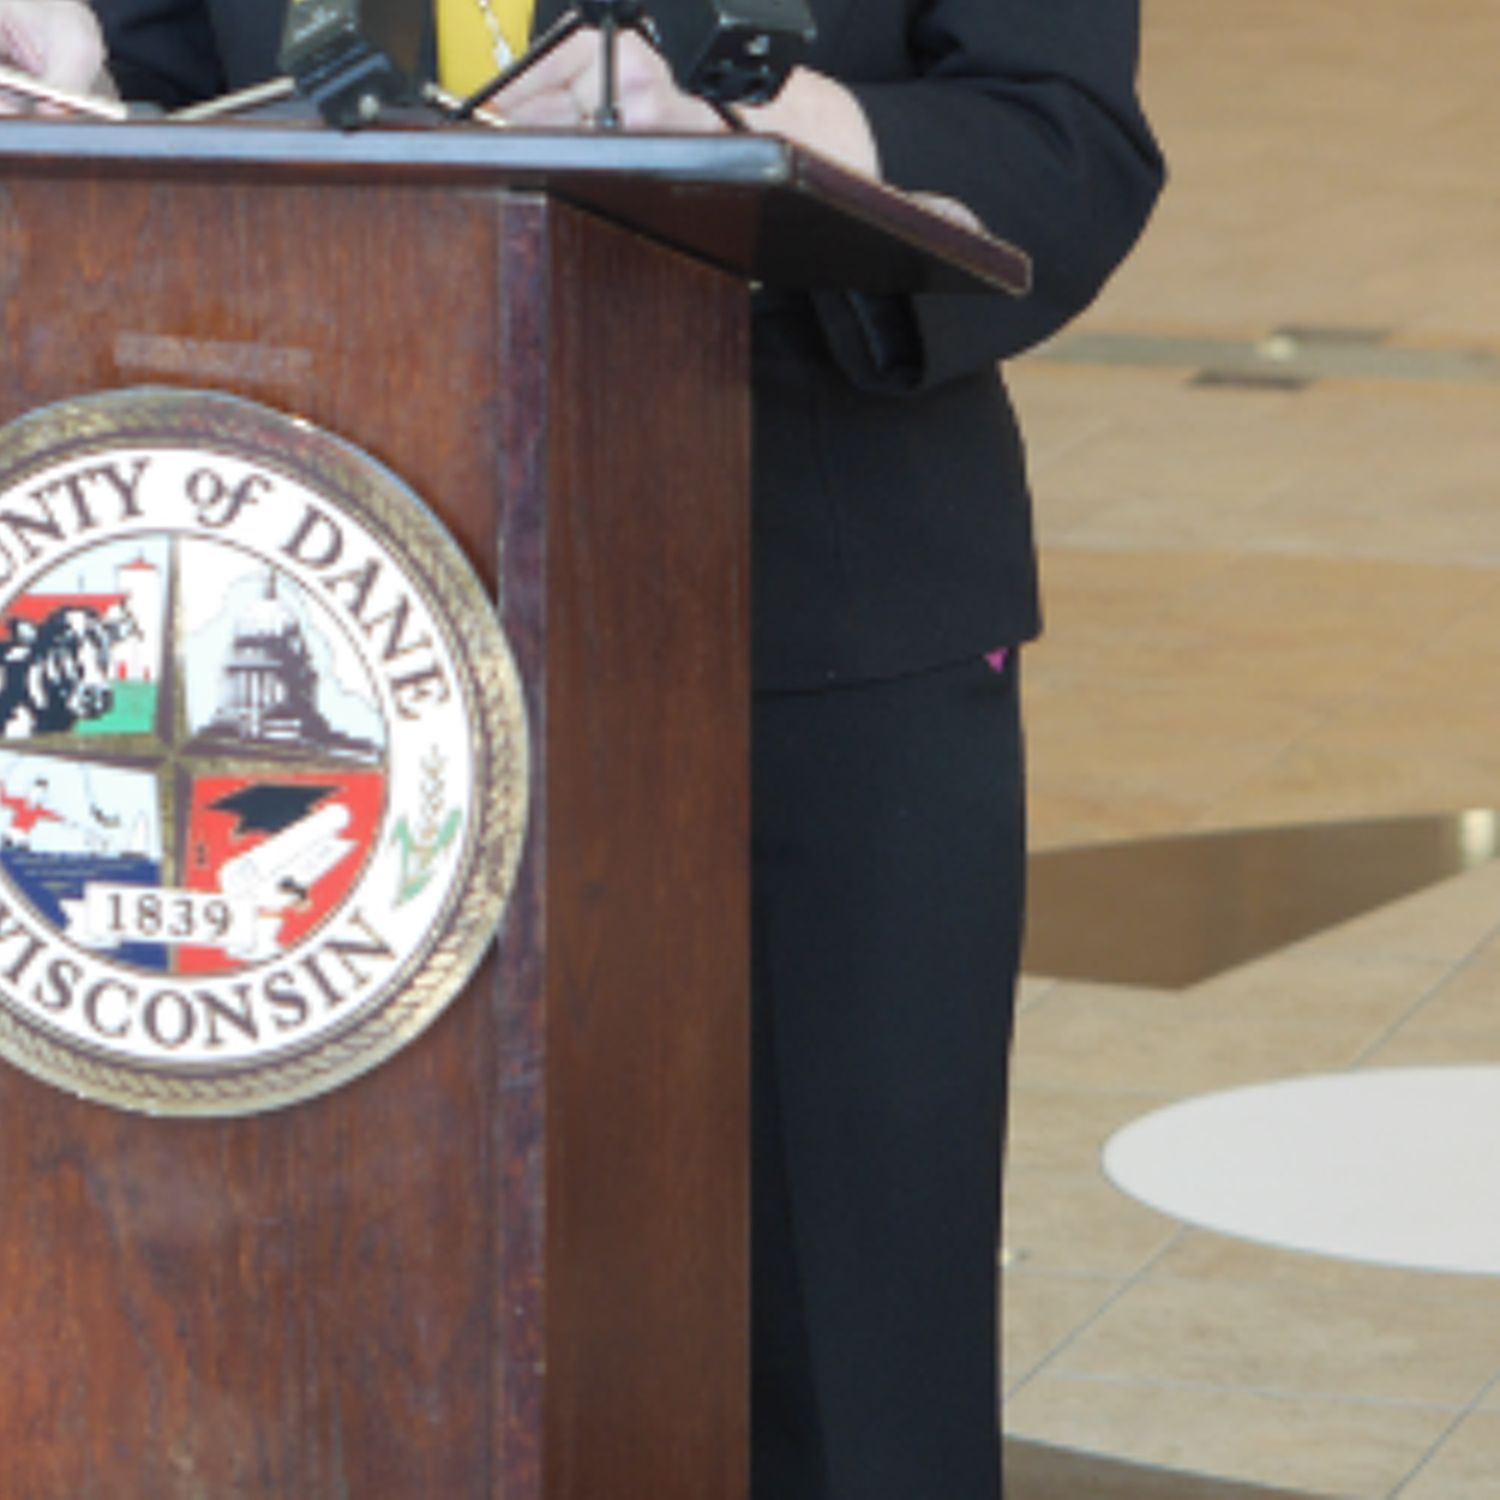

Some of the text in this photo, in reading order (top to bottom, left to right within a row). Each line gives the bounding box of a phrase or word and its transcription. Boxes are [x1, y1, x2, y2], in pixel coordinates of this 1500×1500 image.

[185, 467, 274, 529] of
[280, 502, 451, 722] DANE
[106, 892, 232, 939] 1839
